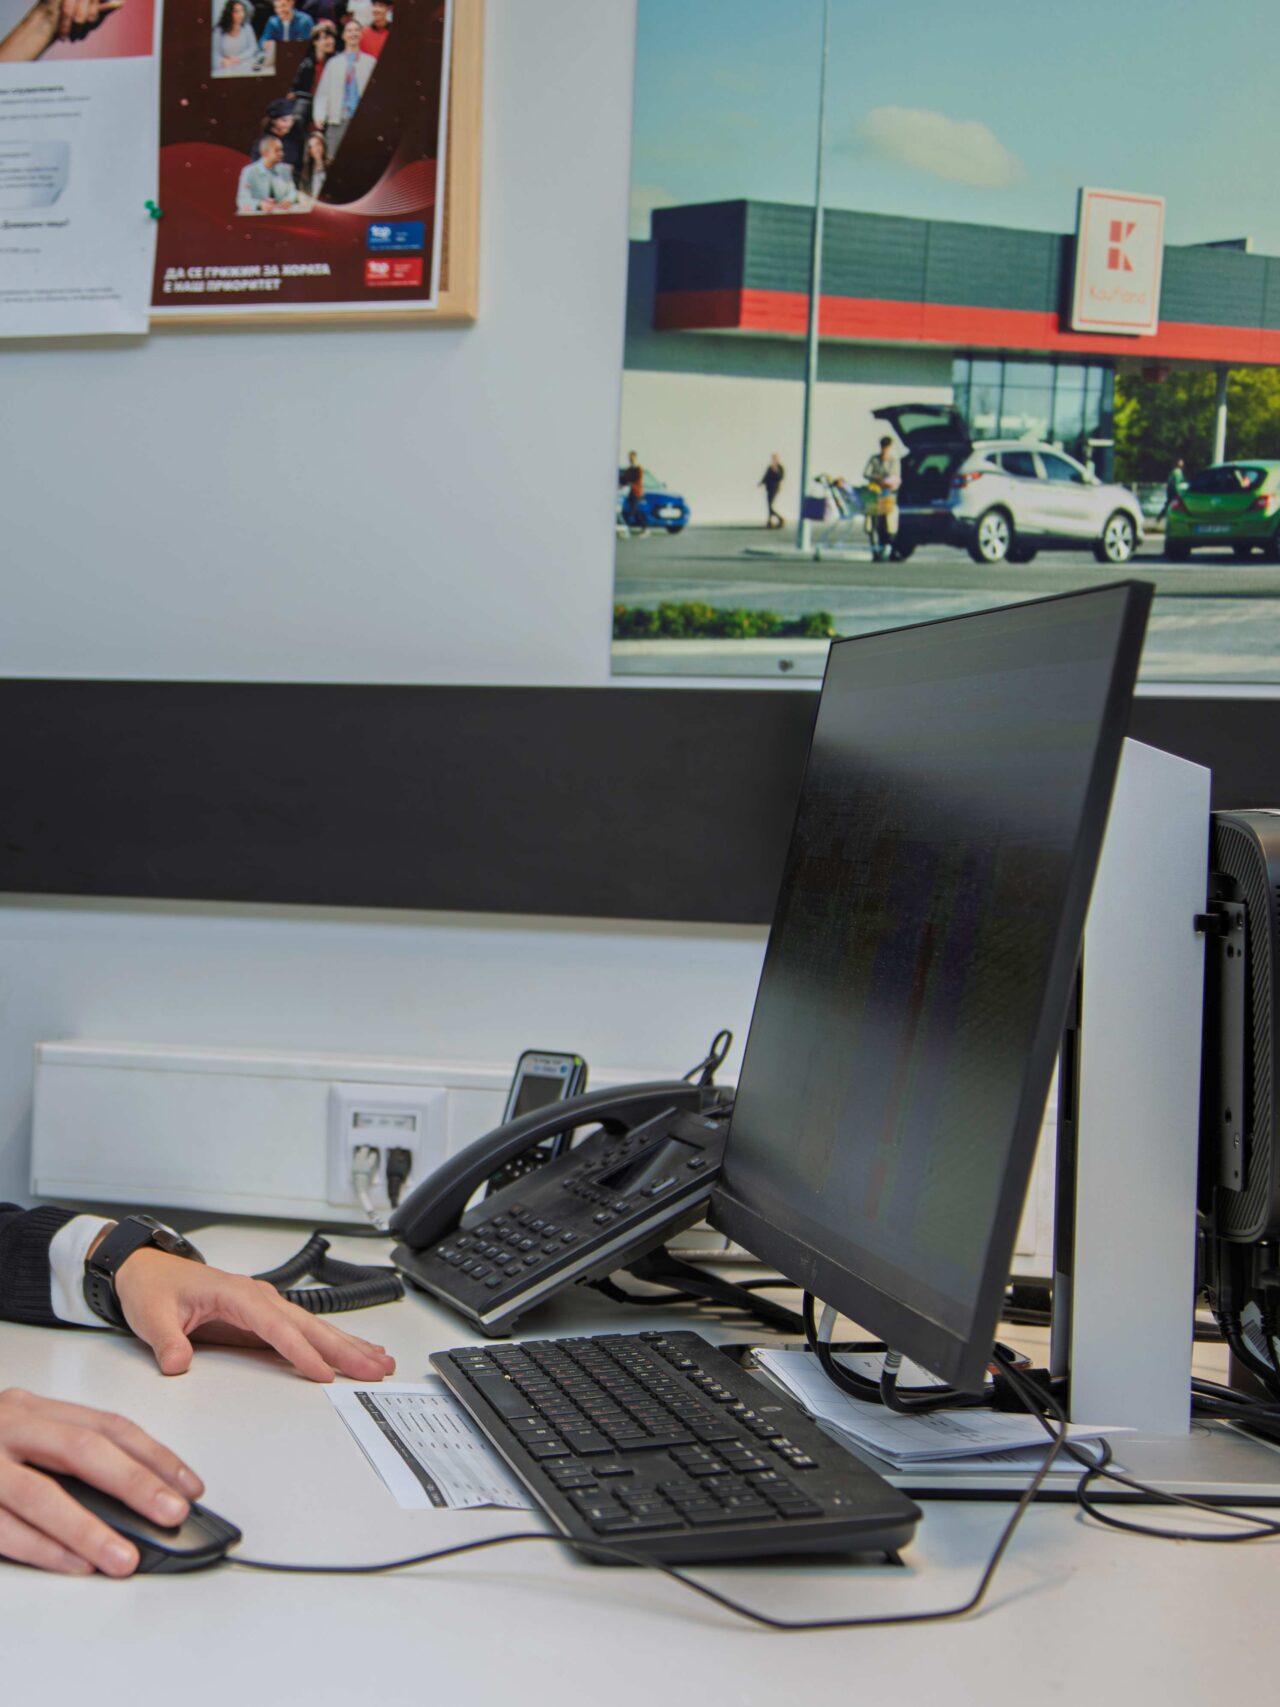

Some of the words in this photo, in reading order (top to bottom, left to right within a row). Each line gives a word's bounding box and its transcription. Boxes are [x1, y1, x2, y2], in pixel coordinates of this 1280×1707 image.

[164, 267, 185, 281] ДА
[187, 266, 203, 279] СЕ
[204, 265, 261, 279] ГРИЖИМ
[263, 264, 280, 277] ЗА
[281, 263, 331, 276] ХОРАТА
[174, 280, 205, 293] НАШ
[206, 278, 282, 292] ПРИОРИТЕТ
